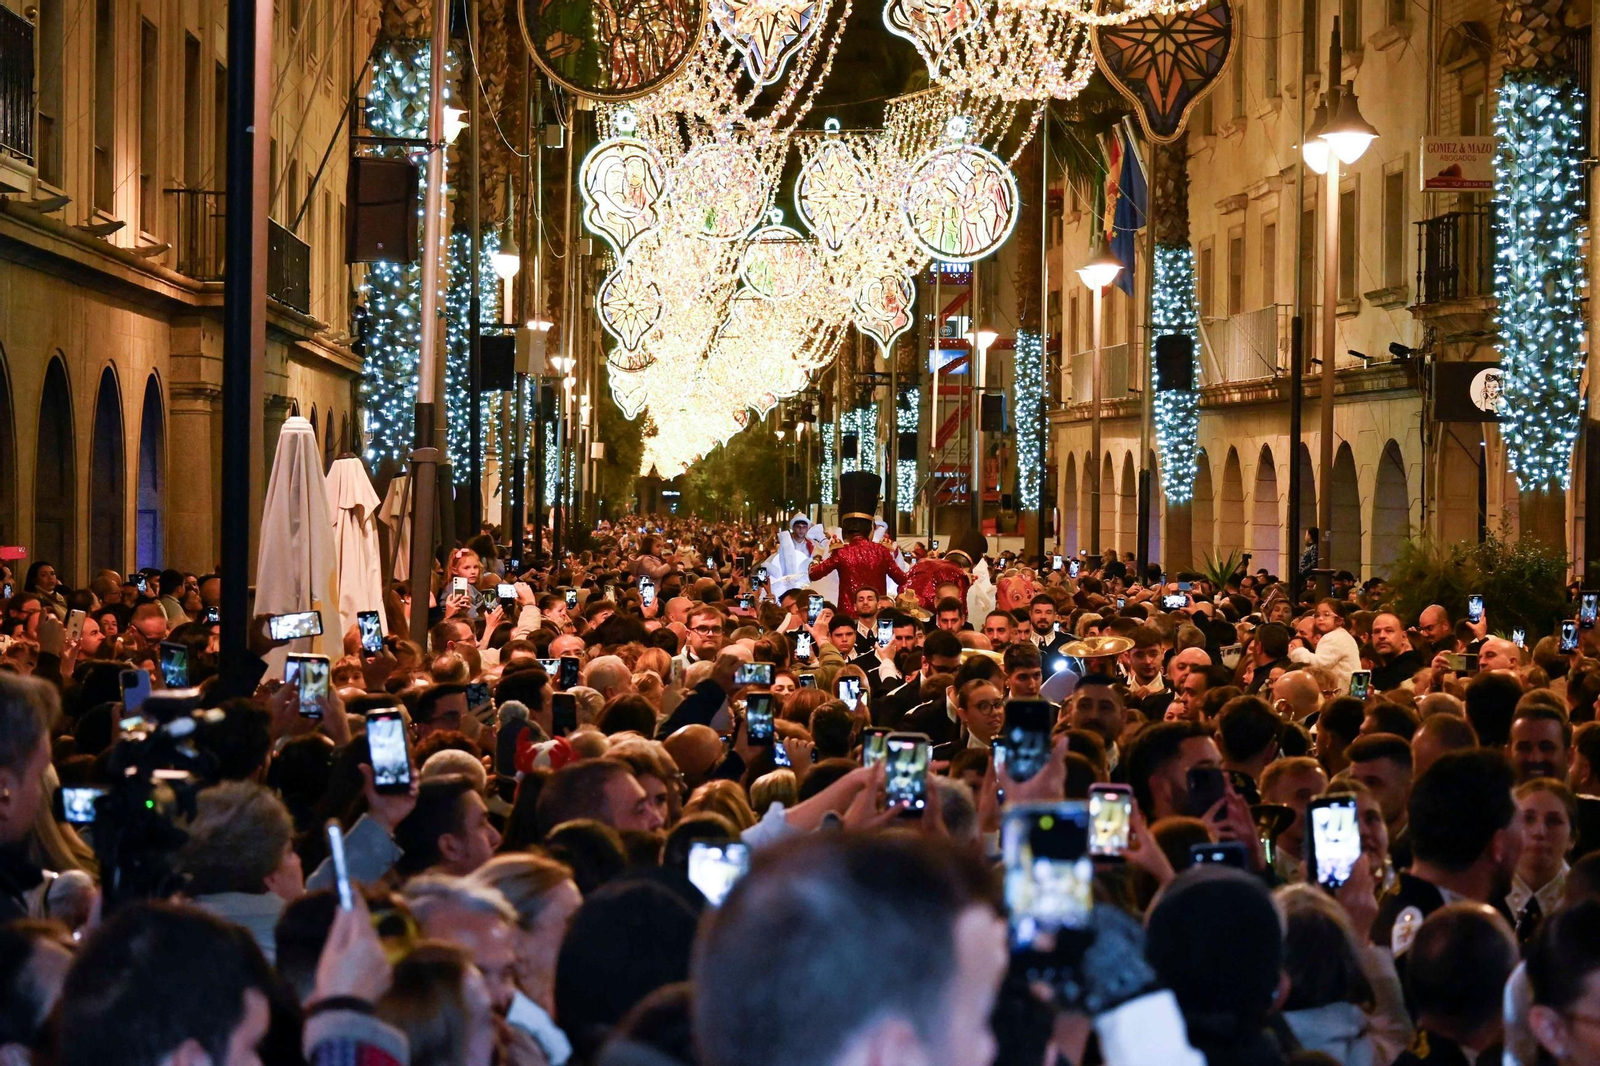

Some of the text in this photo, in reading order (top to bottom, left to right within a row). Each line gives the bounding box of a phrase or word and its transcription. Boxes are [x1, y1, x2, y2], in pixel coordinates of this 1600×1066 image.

[1427, 143, 1492, 154] GOMEZ & MAZO
[1439, 154, 1477, 162] ABOGADOS
